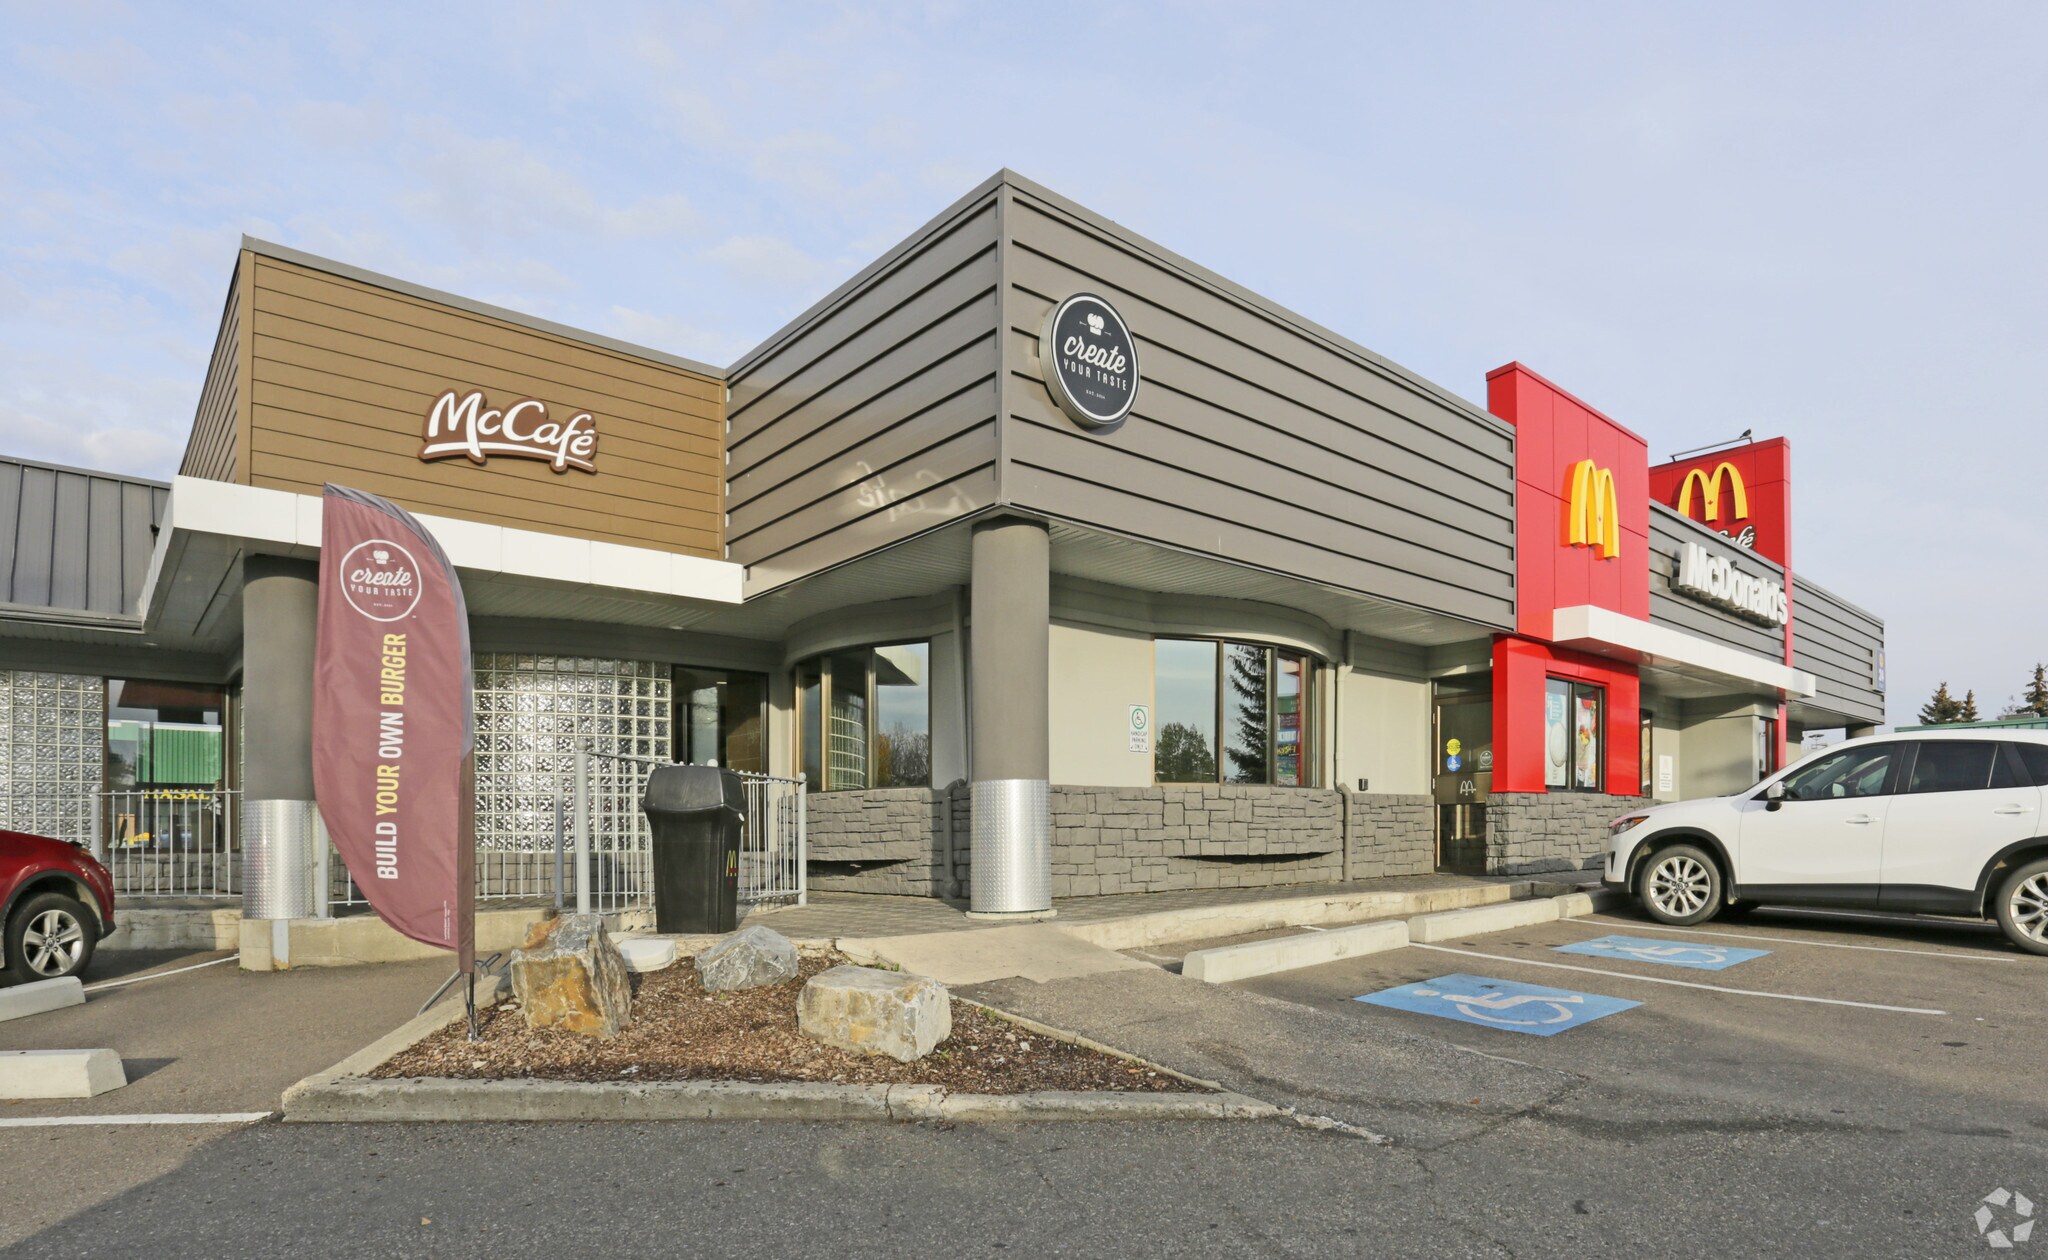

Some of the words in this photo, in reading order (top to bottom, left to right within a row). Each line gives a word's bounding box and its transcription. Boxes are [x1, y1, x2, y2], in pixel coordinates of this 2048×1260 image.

[1063, 358, 1091, 378] YOUR
[1096, 370, 1127, 391] TASTE
[1064, 336, 1126, 374] create
[424, 392, 596, 467] McCafé
[350, 566, 411, 586] create
[350, 584, 378, 595] YOUR
[385, 588, 412, 596] TASTE
[1679, 541, 1788, 624] McDonald's
[380, 633, 407, 706] BURGER
[378, 711, 404, 759] OWN
[375, 764, 400, 817] YOUR
[375, 822, 399, 880] BUILD
